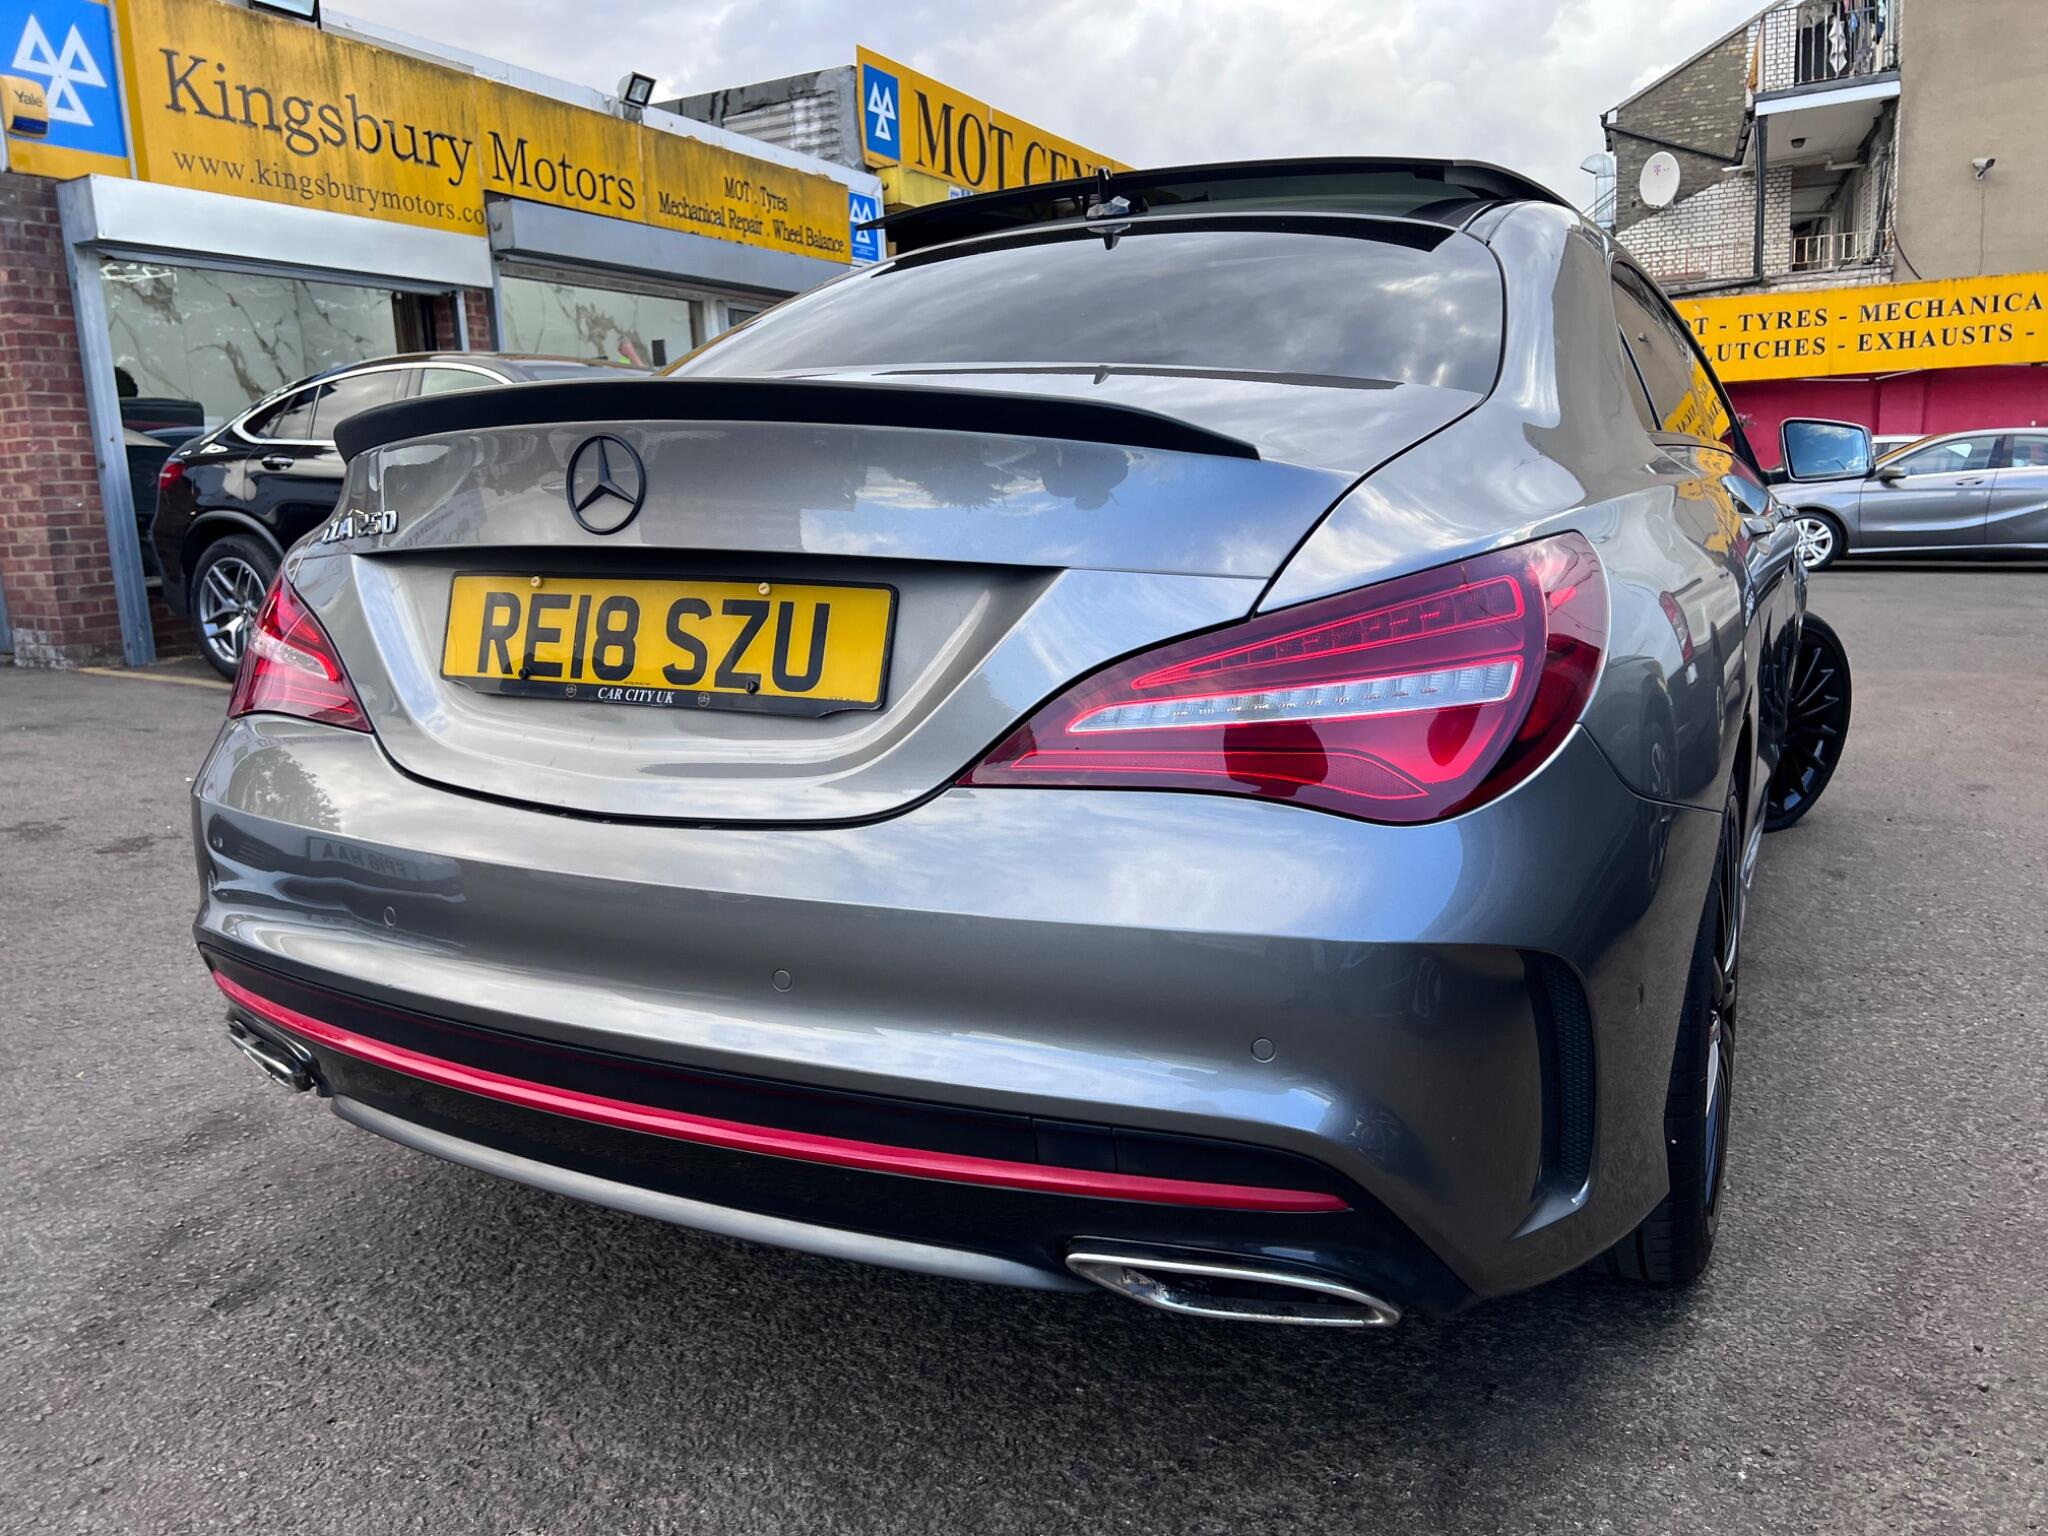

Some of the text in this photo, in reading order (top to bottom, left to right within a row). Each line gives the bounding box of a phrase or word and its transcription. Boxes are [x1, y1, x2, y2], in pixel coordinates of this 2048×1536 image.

[13, 89, 43, 108] Yale
[159, 48, 636, 210] Kingsbury Motors
[913, 89, 1013, 191] MOT
[724, 177, 751, 202] MOT
[760, 186, 788, 213] Tyres
[658, 191, 725, 227] Mechanical
[729, 208, 764, 237] Repair
[773, 220, 803, 245] Wheel
[807, 231, 845, 253] Balance
[1738, 308, 1828, 332] TYRES
[1859, 291, 2042, 323] MECHANICA
[1857, 323, 2013, 352] EXHAUSTS
[355, 510, 398, 537] 250
[477, 591, 831, 693] RE18 SZU
[598, 687, 675, 704] CAR CITY UK
